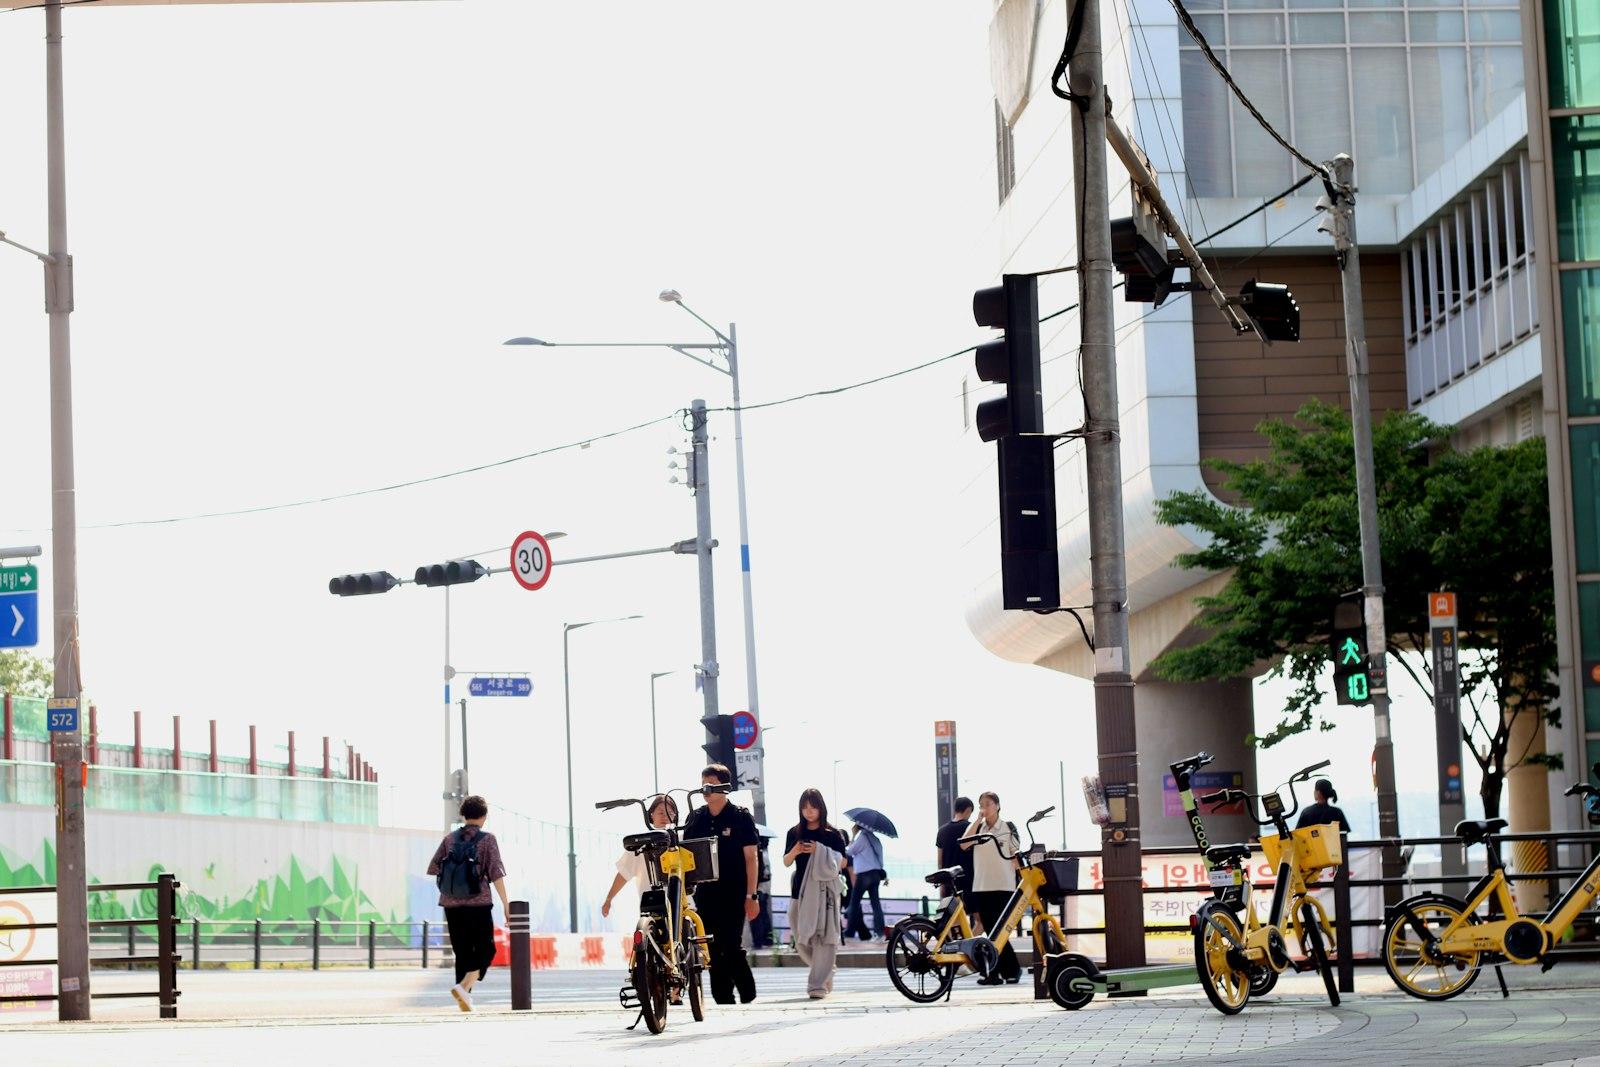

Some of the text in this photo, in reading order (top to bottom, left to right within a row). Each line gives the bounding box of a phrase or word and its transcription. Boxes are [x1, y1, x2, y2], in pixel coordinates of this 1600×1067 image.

[518, 546, 544, 575] 30
[1442, 630, 1452, 645] 3
[1347, 672, 1368, 701] 10
[51, 713, 73, 727] 572
[1191, 815, 1209, 848] GCOO
